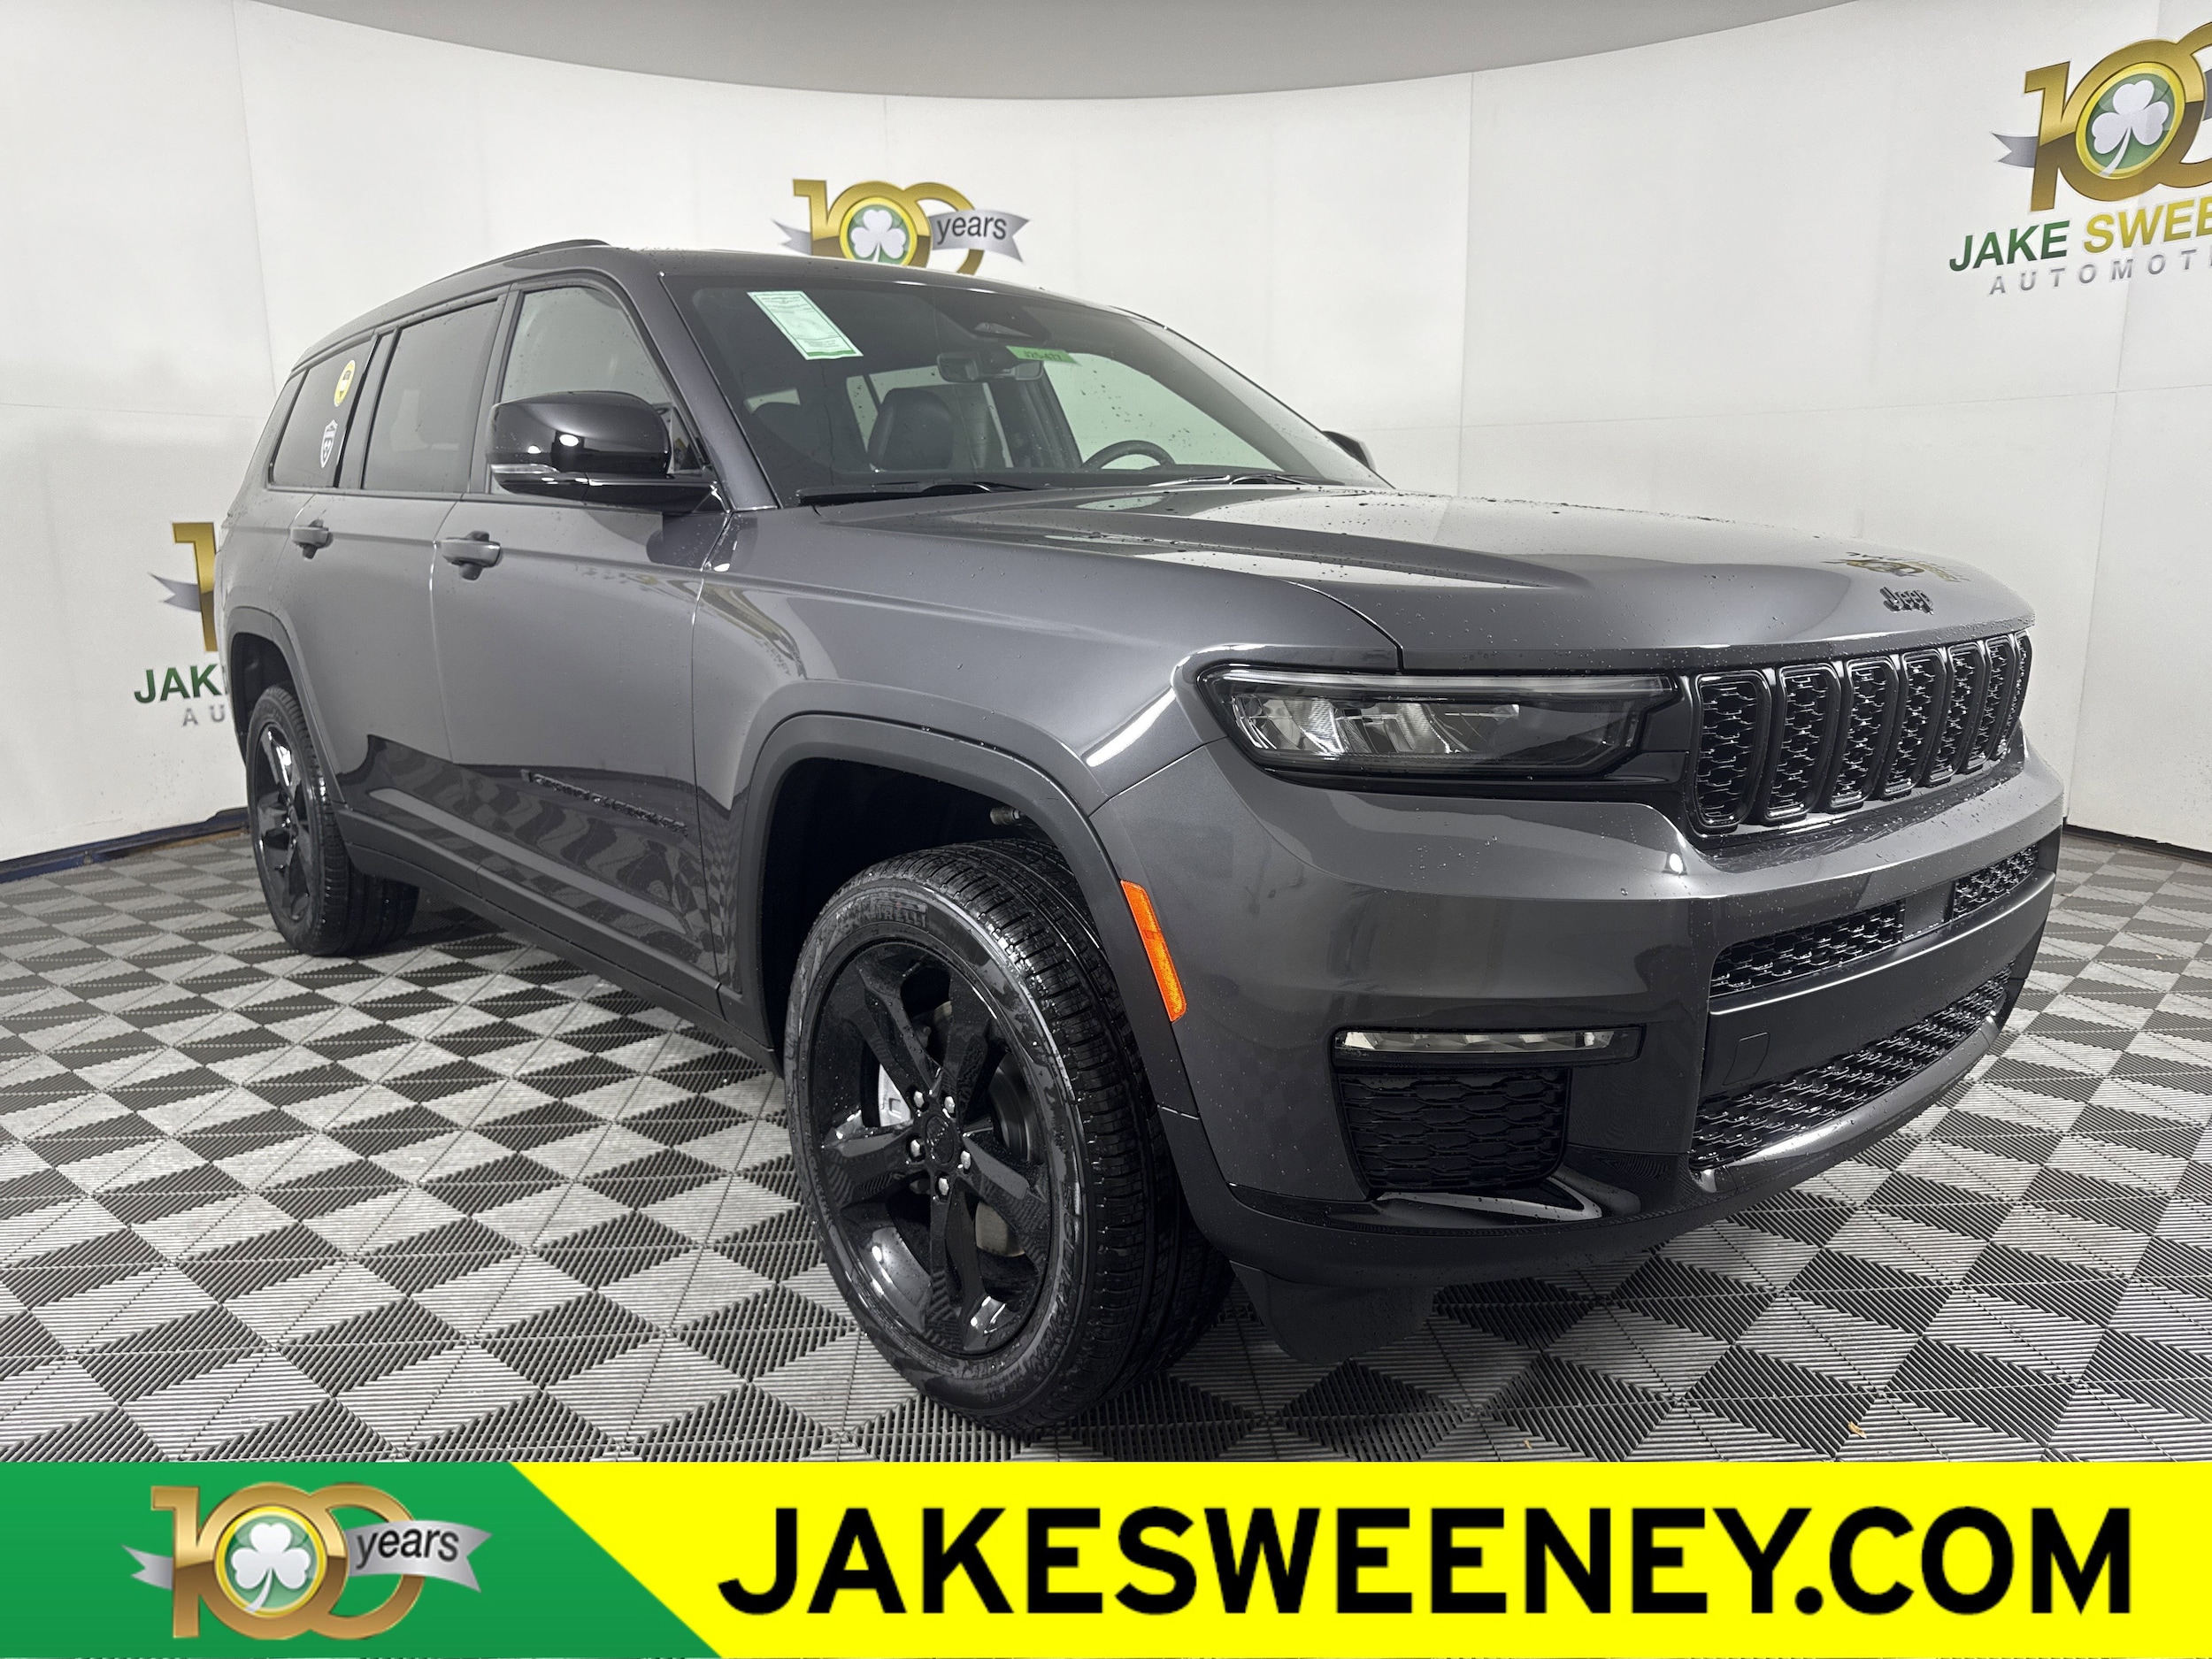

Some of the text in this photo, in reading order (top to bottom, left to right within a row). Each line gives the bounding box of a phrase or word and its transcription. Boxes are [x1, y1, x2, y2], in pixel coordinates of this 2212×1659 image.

[937, 215, 1007, 244] years
[1949, 219, 2071, 272] JAKE
[1880, 587, 1934, 616] Jeep
[134, 664, 227, 703] JAK
